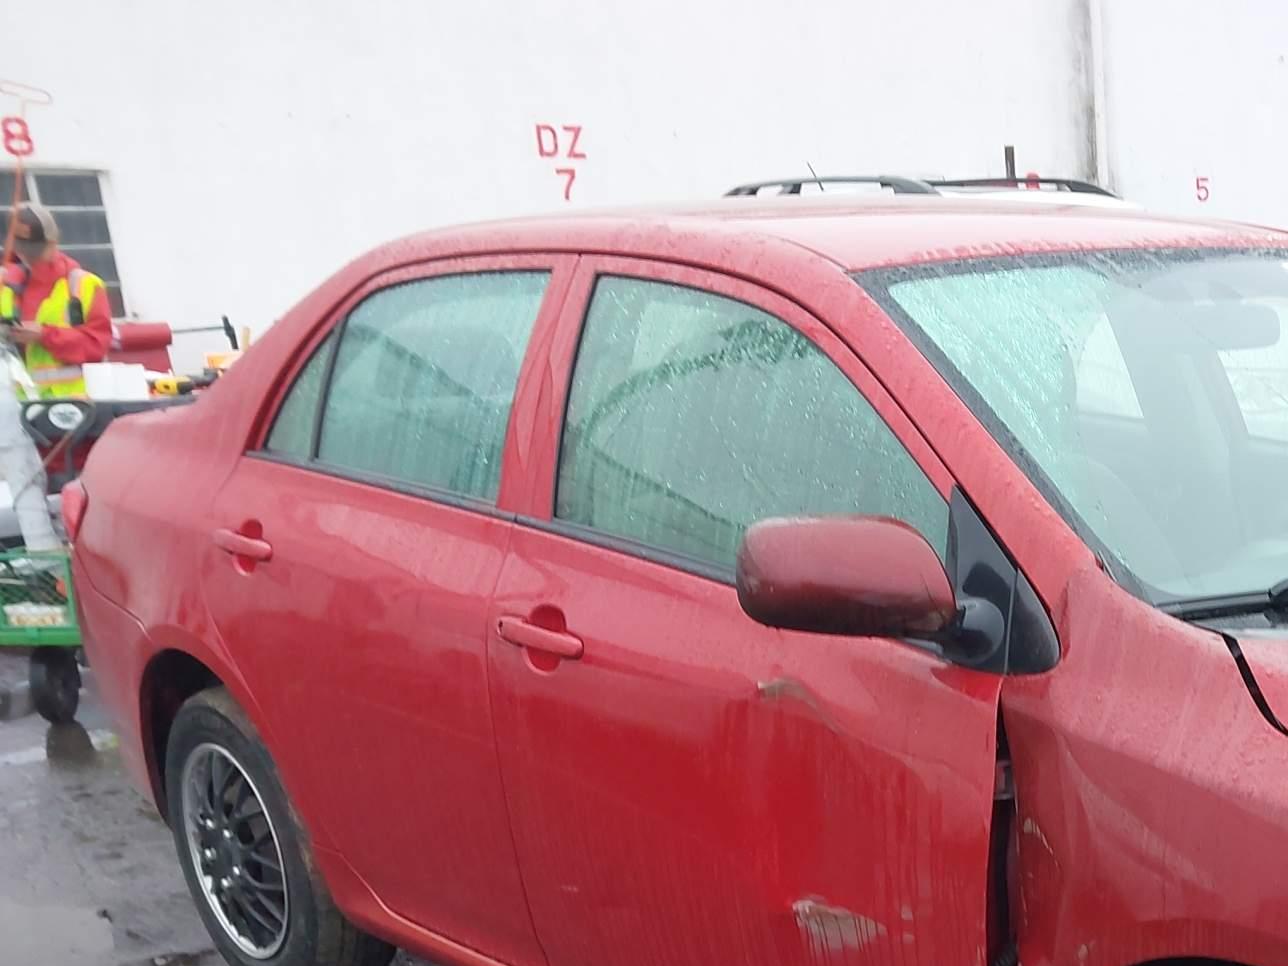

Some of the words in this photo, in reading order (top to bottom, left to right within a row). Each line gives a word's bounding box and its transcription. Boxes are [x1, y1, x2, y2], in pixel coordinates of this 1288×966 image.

[1, 117, 34, 157] 8
[536, 124, 587, 158] DZ
[555, 168, 576, 201] 7
[1196, 177, 1209, 201] 5
